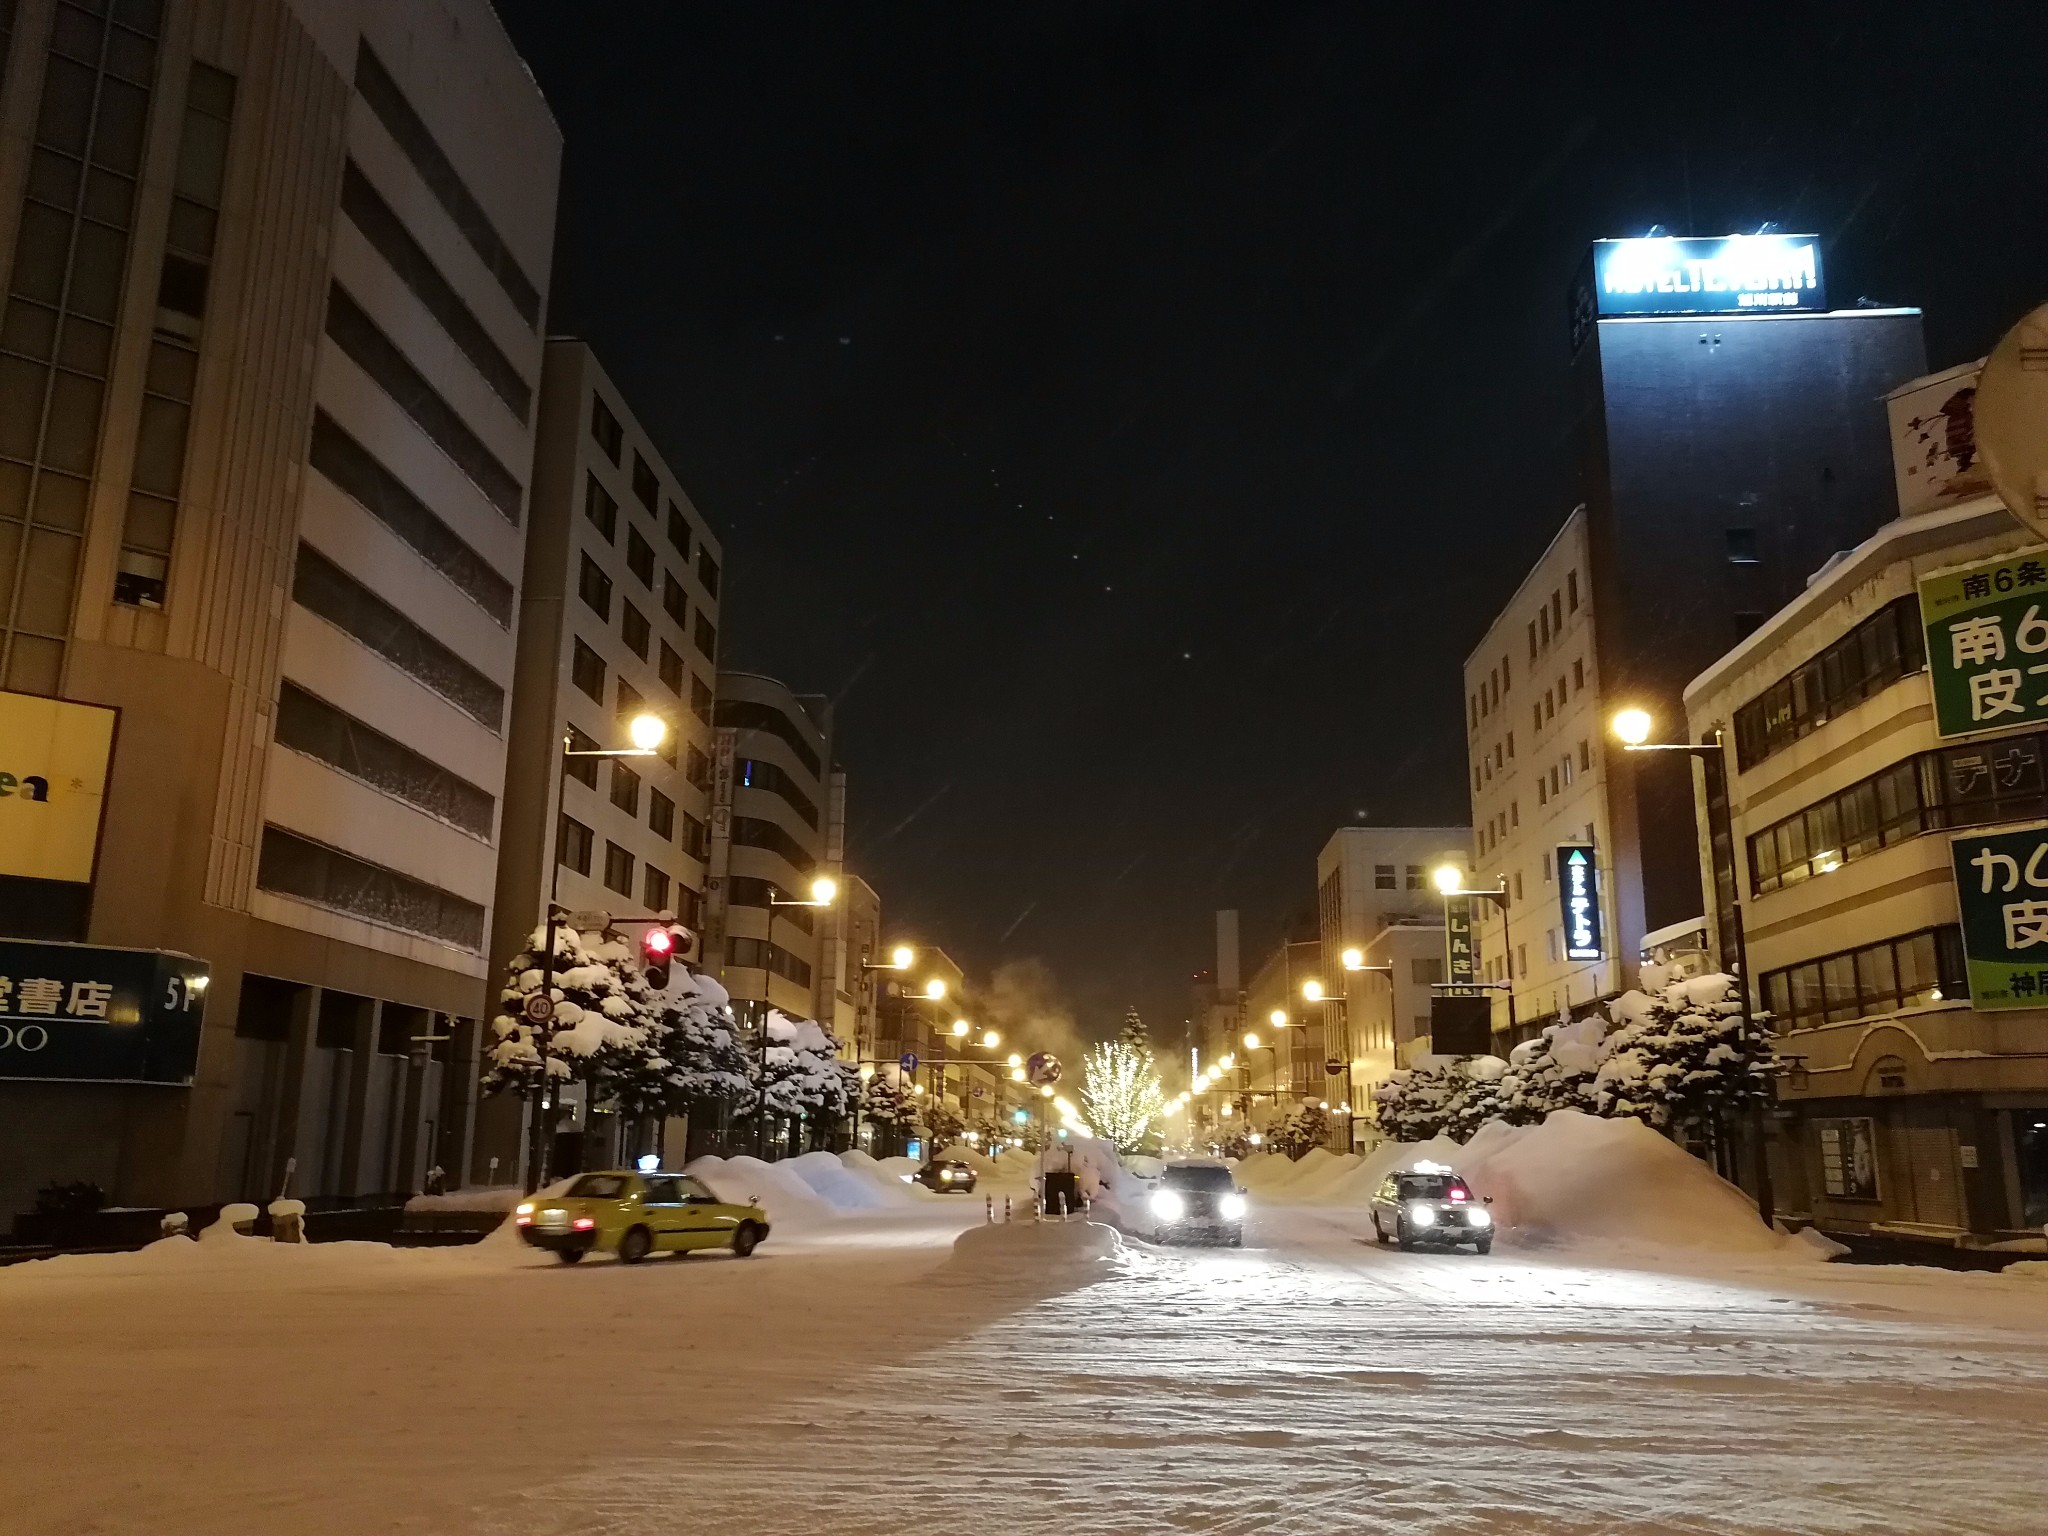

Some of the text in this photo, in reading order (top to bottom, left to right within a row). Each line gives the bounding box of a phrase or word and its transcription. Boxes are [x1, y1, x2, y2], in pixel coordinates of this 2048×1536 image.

[1962, 561, 2047, 601] 南6条
[1949, 604, 2048, 669] 南6
[532, 1002, 548, 1015] 40
